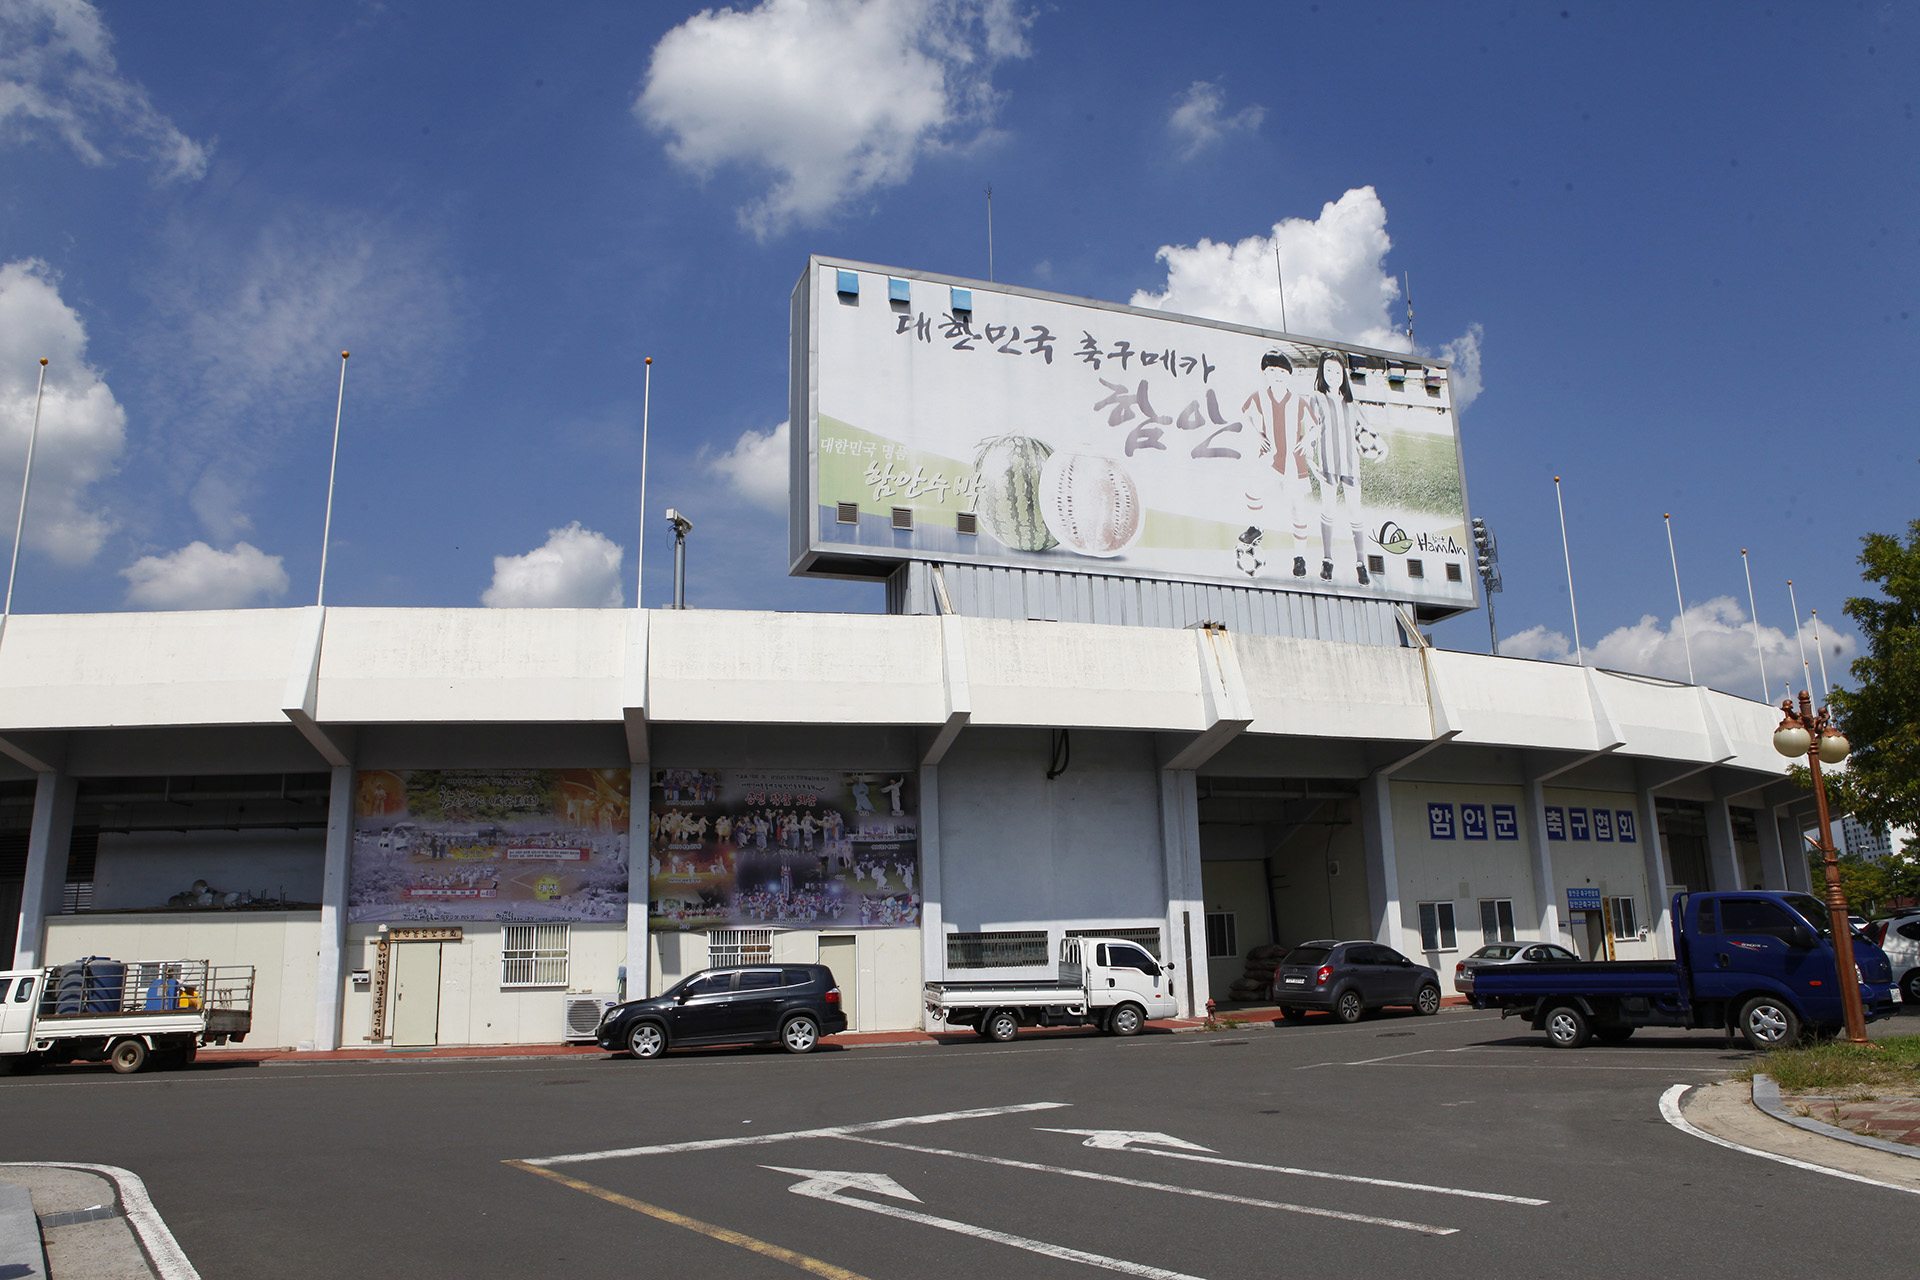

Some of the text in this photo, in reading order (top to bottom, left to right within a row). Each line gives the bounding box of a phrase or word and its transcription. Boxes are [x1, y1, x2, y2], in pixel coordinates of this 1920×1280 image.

[895, 311, 1216, 384] 대한민국 축구메카
[1093, 377, 1244, 459] 함안
[820, 437, 909, 461] 대한민국 명품
[863, 460, 986, 512] 함안수박
[1416, 532, 1466, 556] HamAn
[745, 792, 766, 806] 공연
[1431, 808, 1635, 840] 함안군 축구협회
